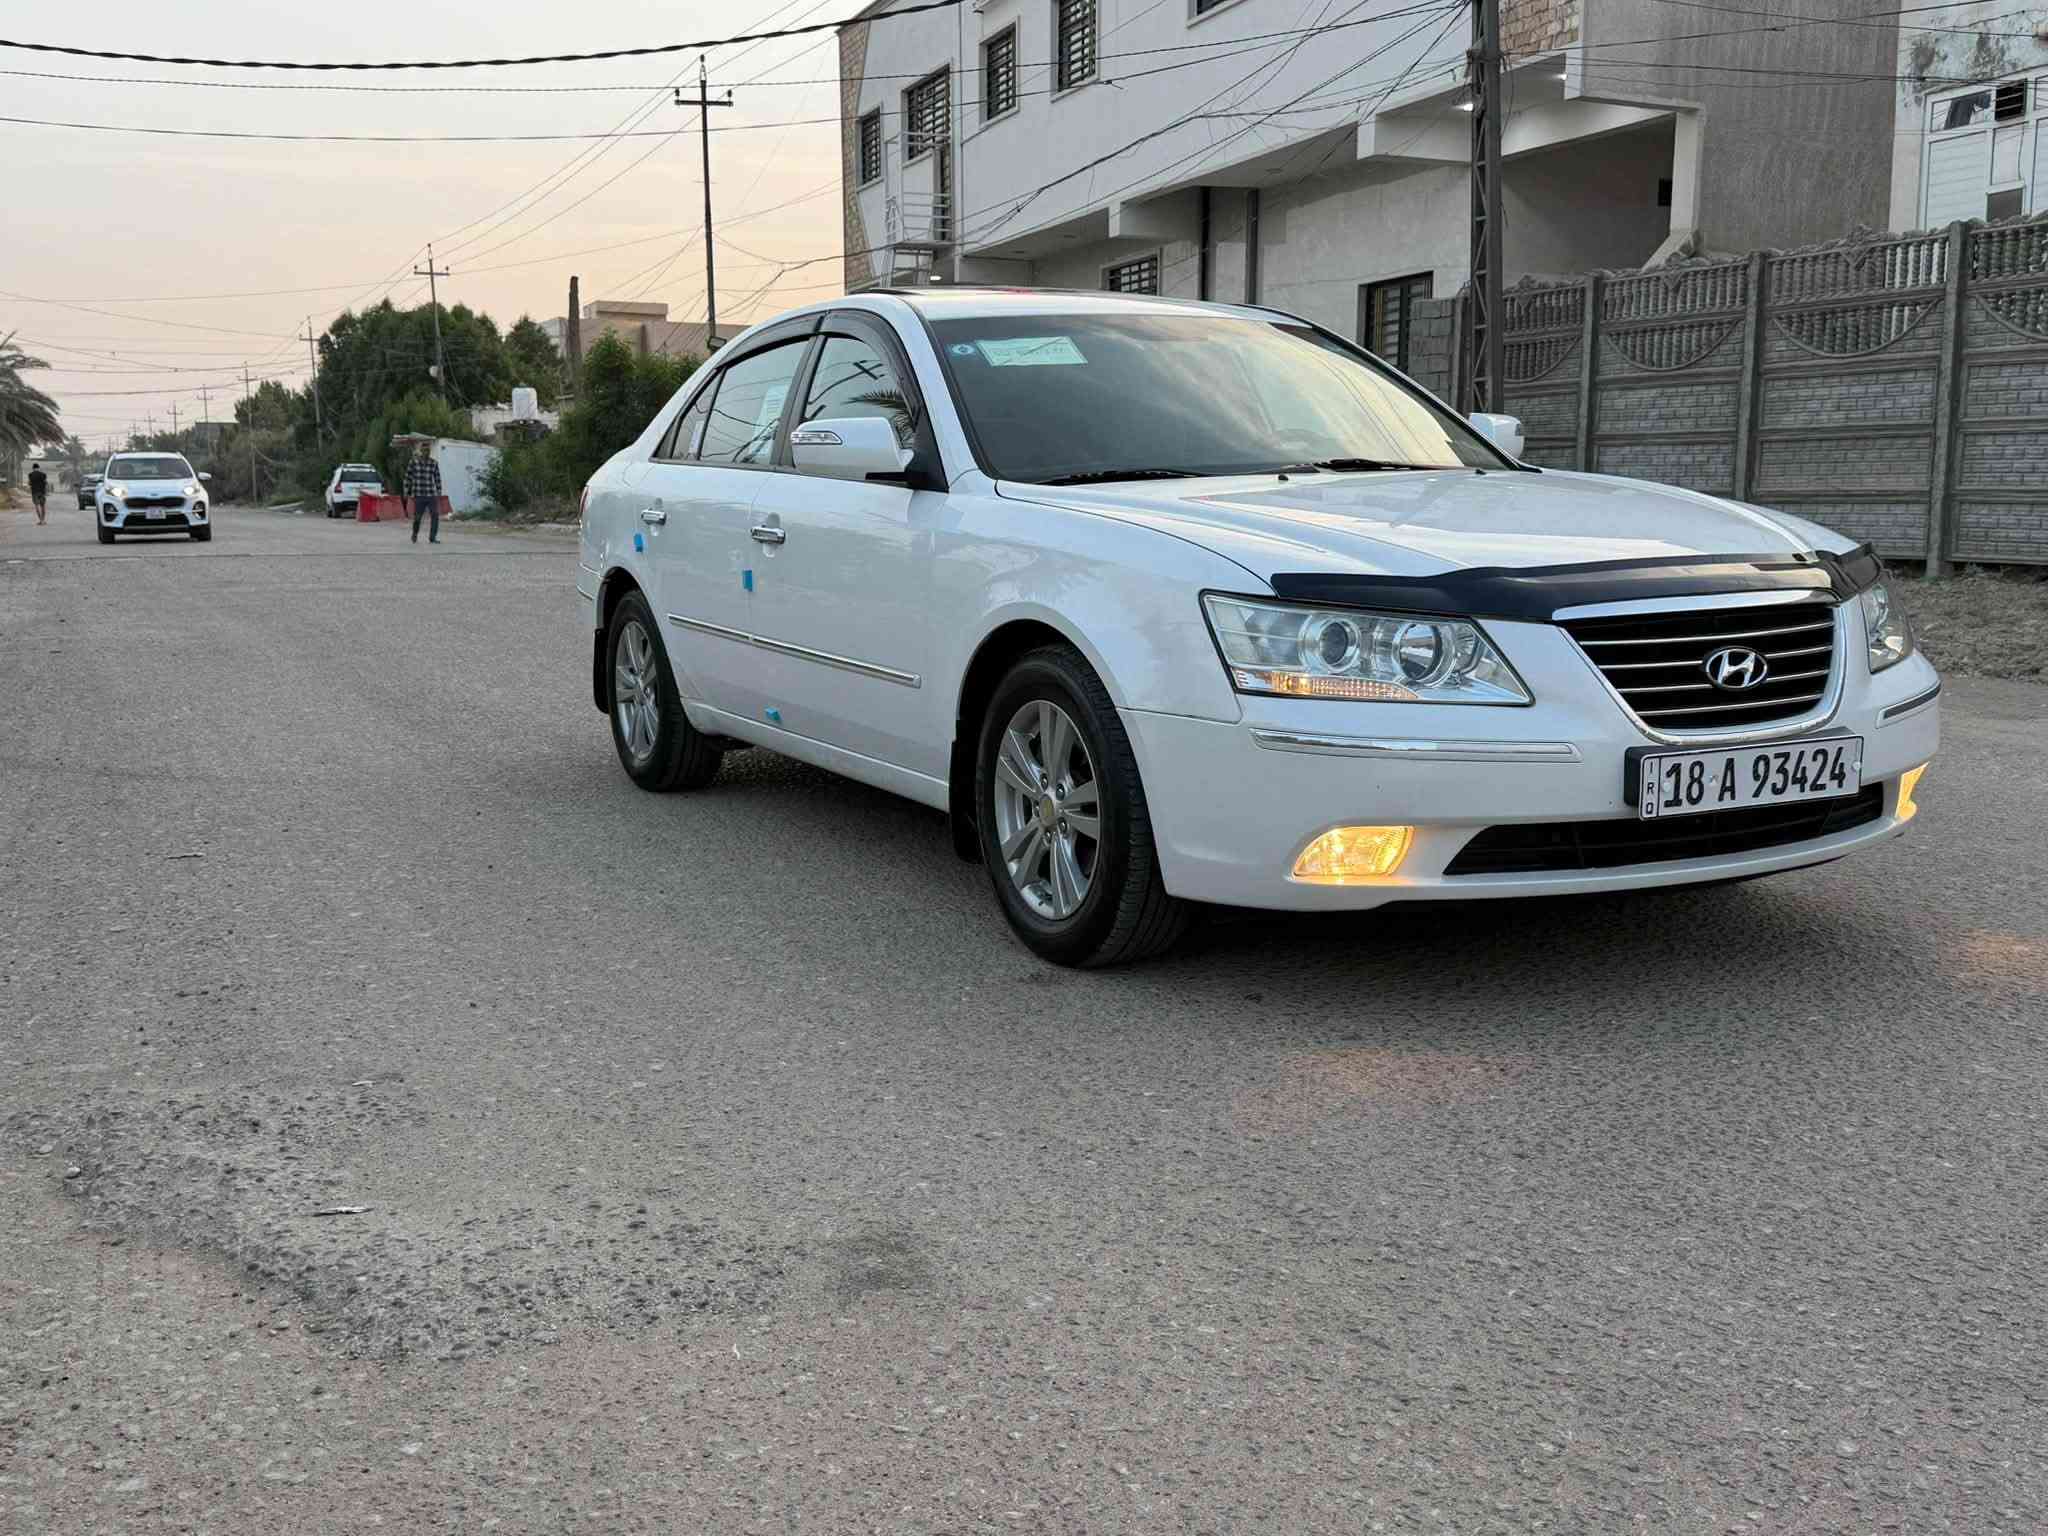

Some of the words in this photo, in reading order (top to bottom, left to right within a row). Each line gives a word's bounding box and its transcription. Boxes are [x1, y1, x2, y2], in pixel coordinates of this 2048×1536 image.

[1664, 761, 1704, 808] 18
[1718, 758, 1736, 801] A
[1752, 747, 1846, 798] 93424
